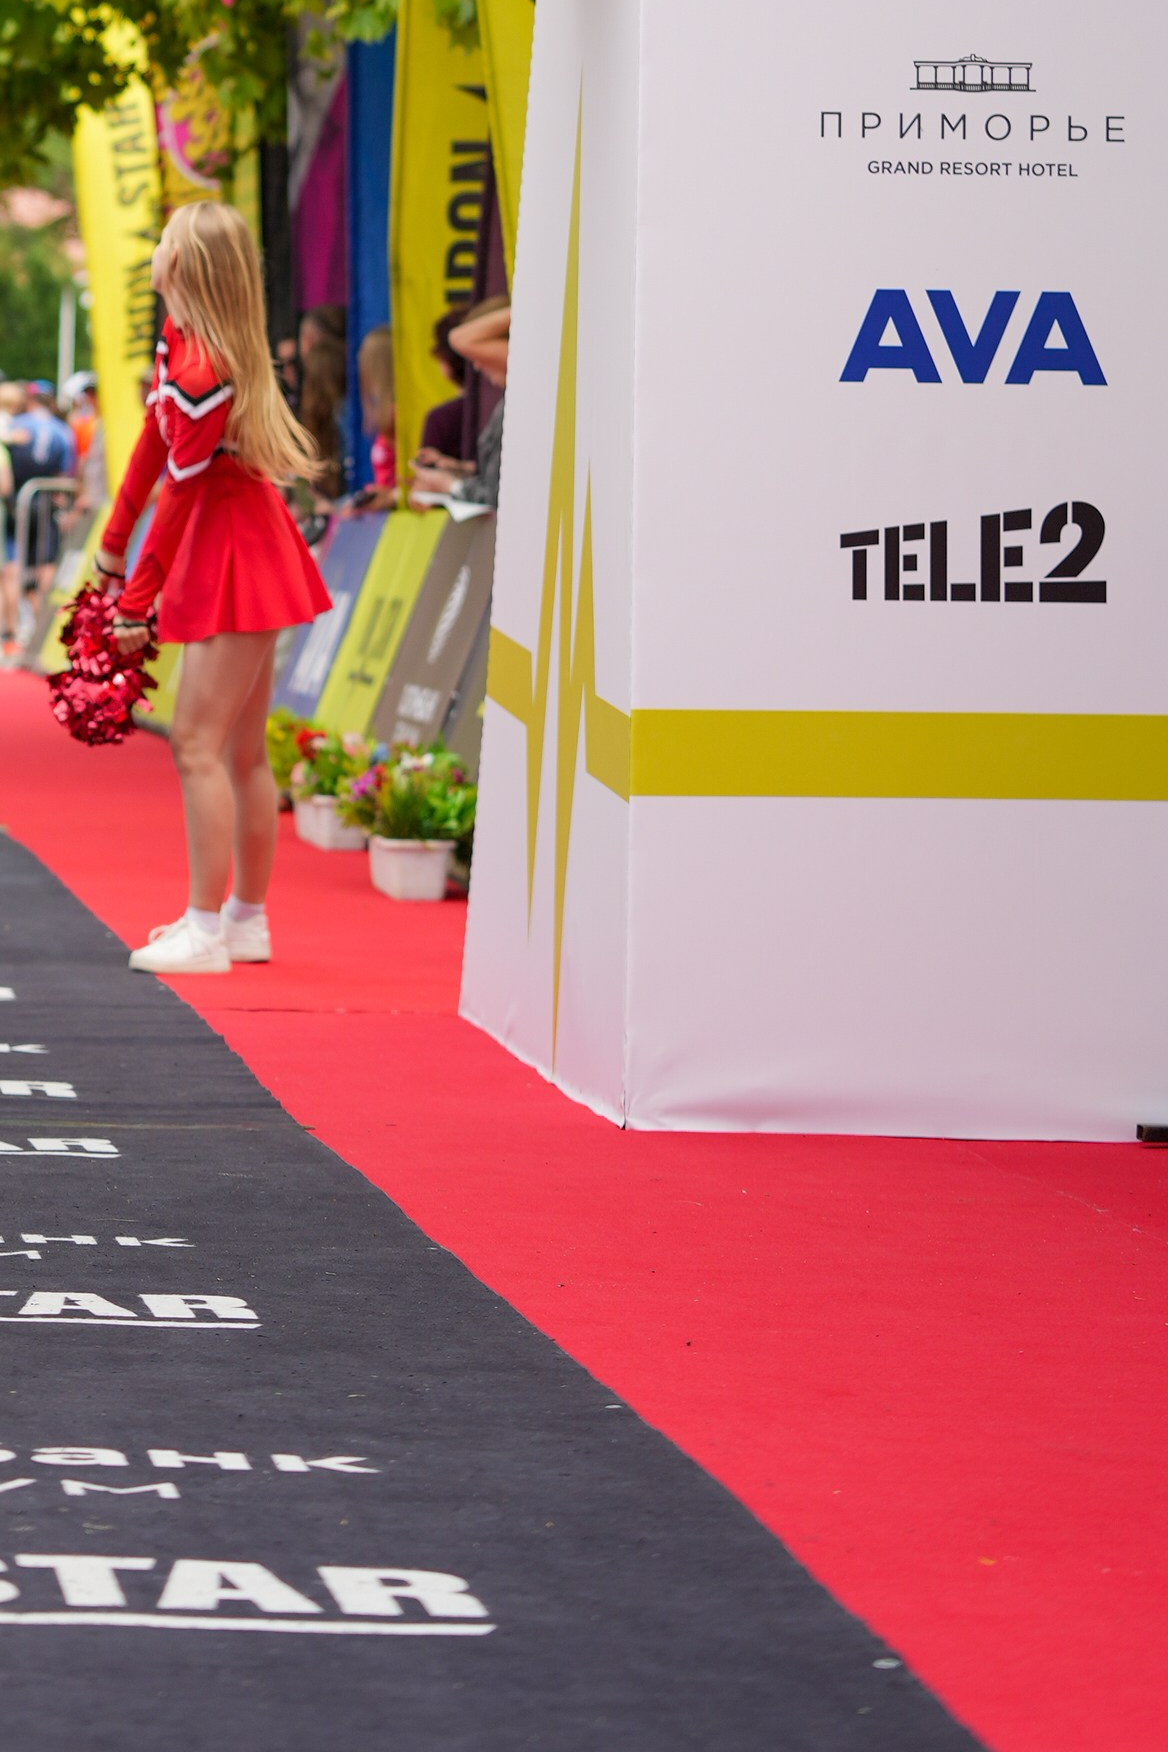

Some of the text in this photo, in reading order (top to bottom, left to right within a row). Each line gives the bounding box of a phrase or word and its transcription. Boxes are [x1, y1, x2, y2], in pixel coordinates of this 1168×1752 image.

[820, 111, 1127, 143] ПРИМОРЬЕ
[867, 159, 1078, 178] GRAND RESORT HOTEL
[839, 289, 1108, 386] AVA
[840, 501, 1107, 604] TELE2
